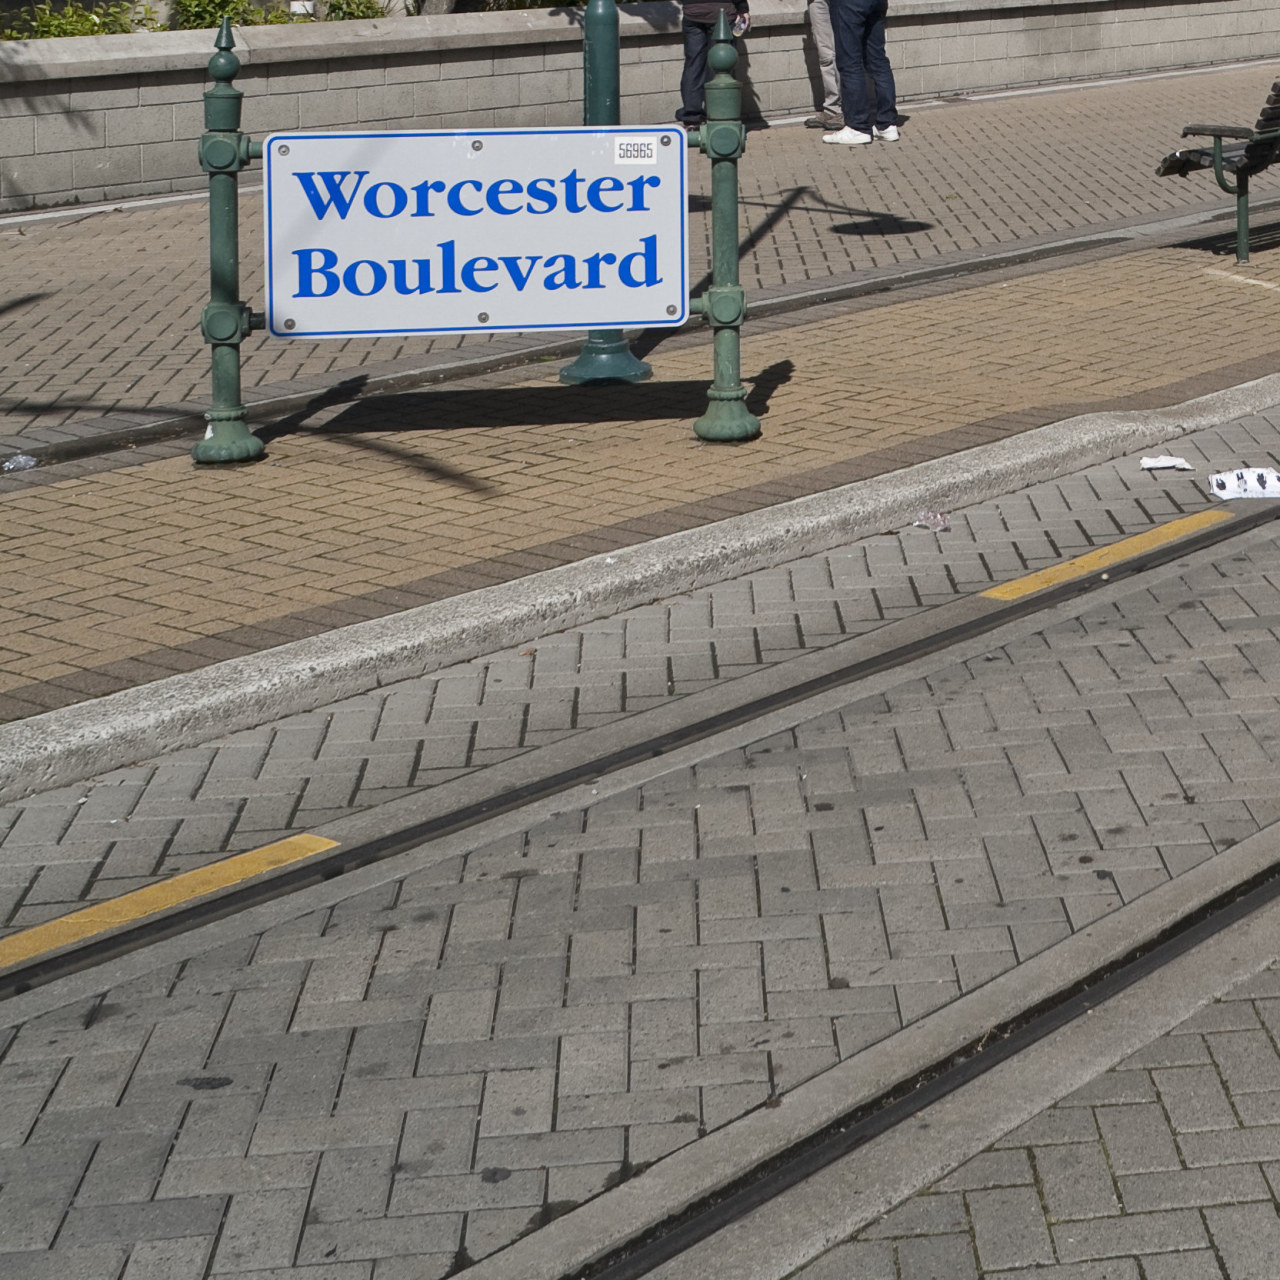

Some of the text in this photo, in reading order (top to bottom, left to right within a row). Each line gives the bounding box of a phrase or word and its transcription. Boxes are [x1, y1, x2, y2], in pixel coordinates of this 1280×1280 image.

[618, 142, 654, 159] 56965
[291, 168, 662, 221] Worcester
[291, 234, 664, 299] Boulevard
